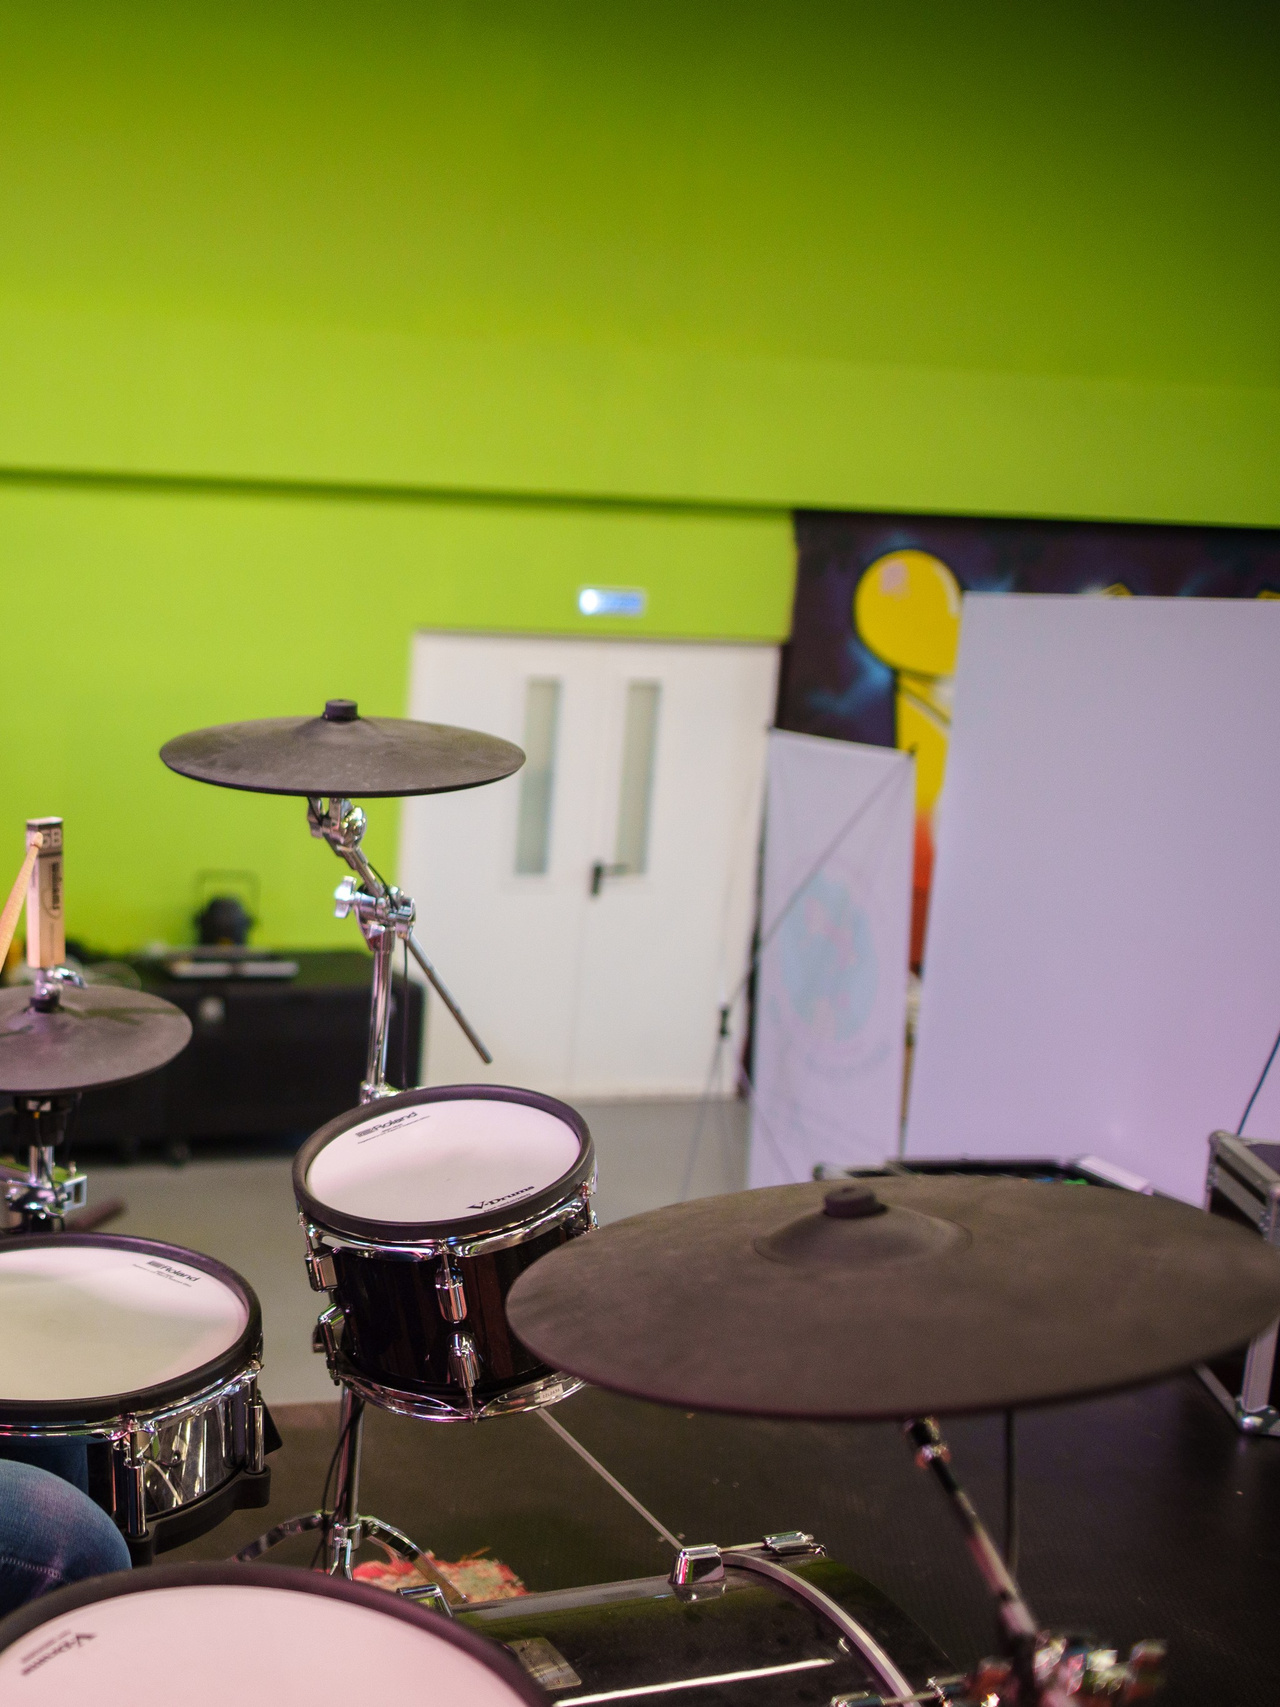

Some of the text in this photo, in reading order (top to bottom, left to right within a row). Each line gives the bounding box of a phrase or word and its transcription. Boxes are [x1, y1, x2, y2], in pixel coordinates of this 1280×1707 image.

[371, 1111, 418, 1131] Roland
[466, 1185, 535, 1209] V-Drums
[160, 1265, 201, 1282] Roland
